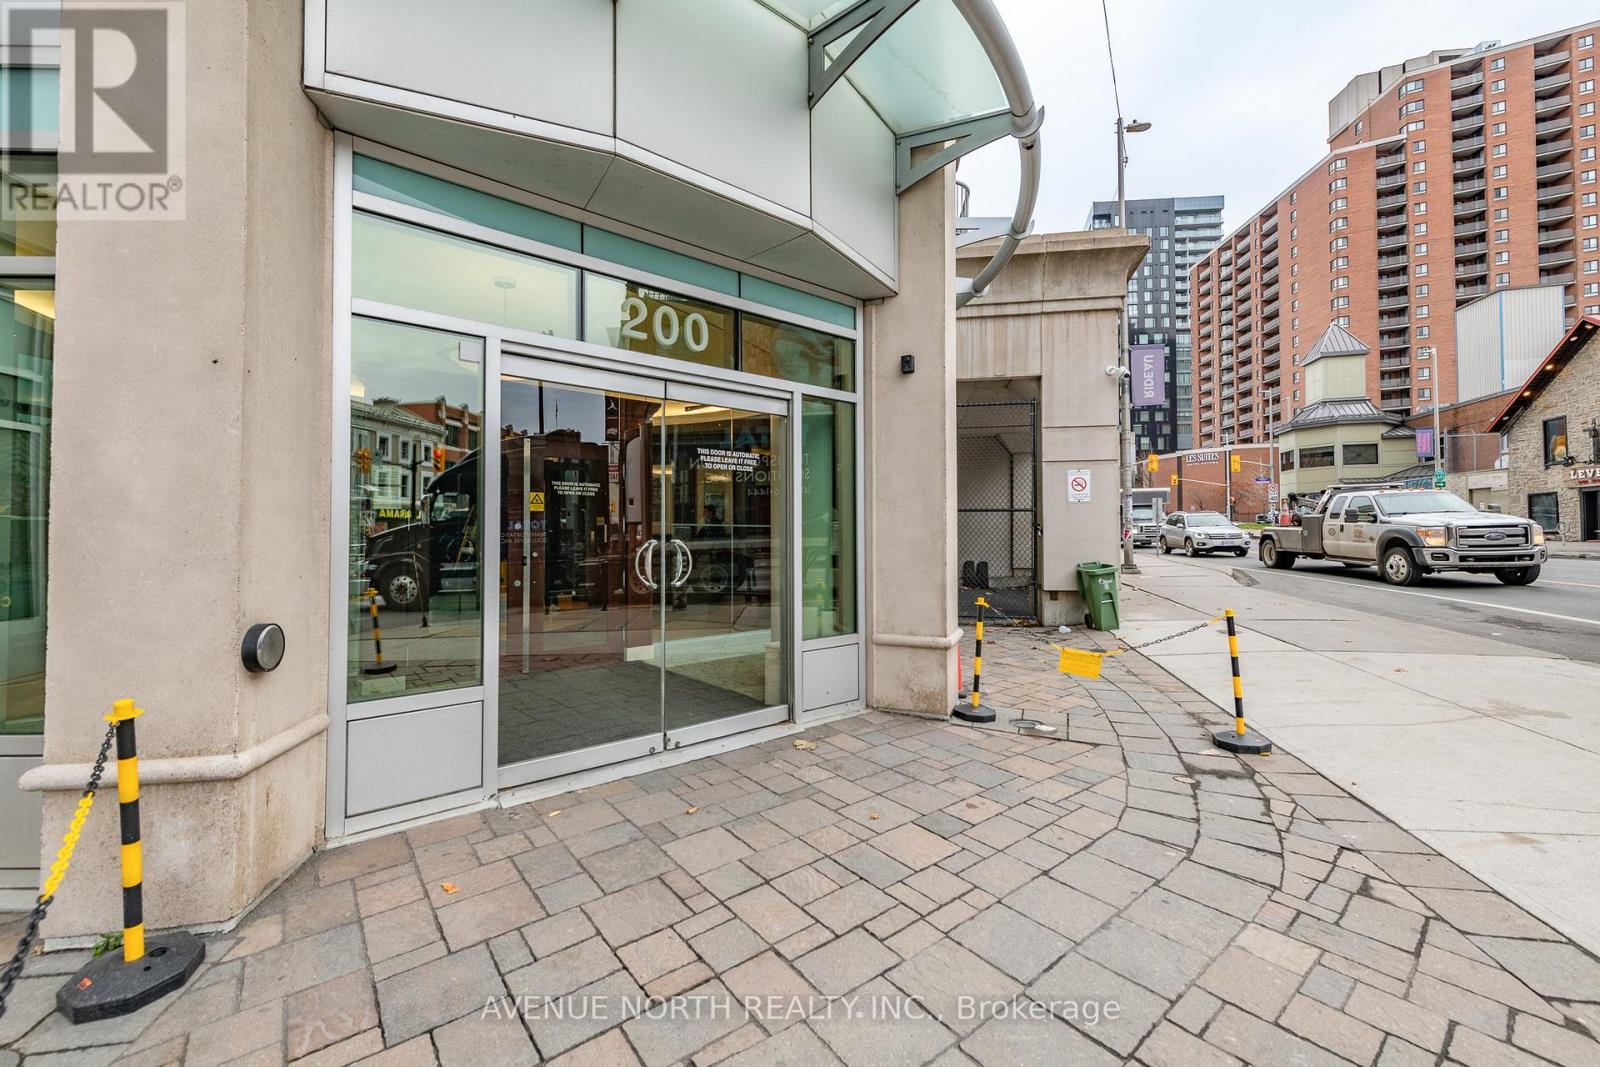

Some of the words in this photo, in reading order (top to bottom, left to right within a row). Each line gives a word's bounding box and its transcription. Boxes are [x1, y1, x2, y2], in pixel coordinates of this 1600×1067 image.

[621, 297, 709, 352] 200
[697, 447, 710, 455] THIS
[732, 451, 760, 459] AUTOMATIC
[1186, 454, 1197, 463] LES
[1197, 452, 1220, 462] SUITES
[700, 455, 721, 463] PLEASE
